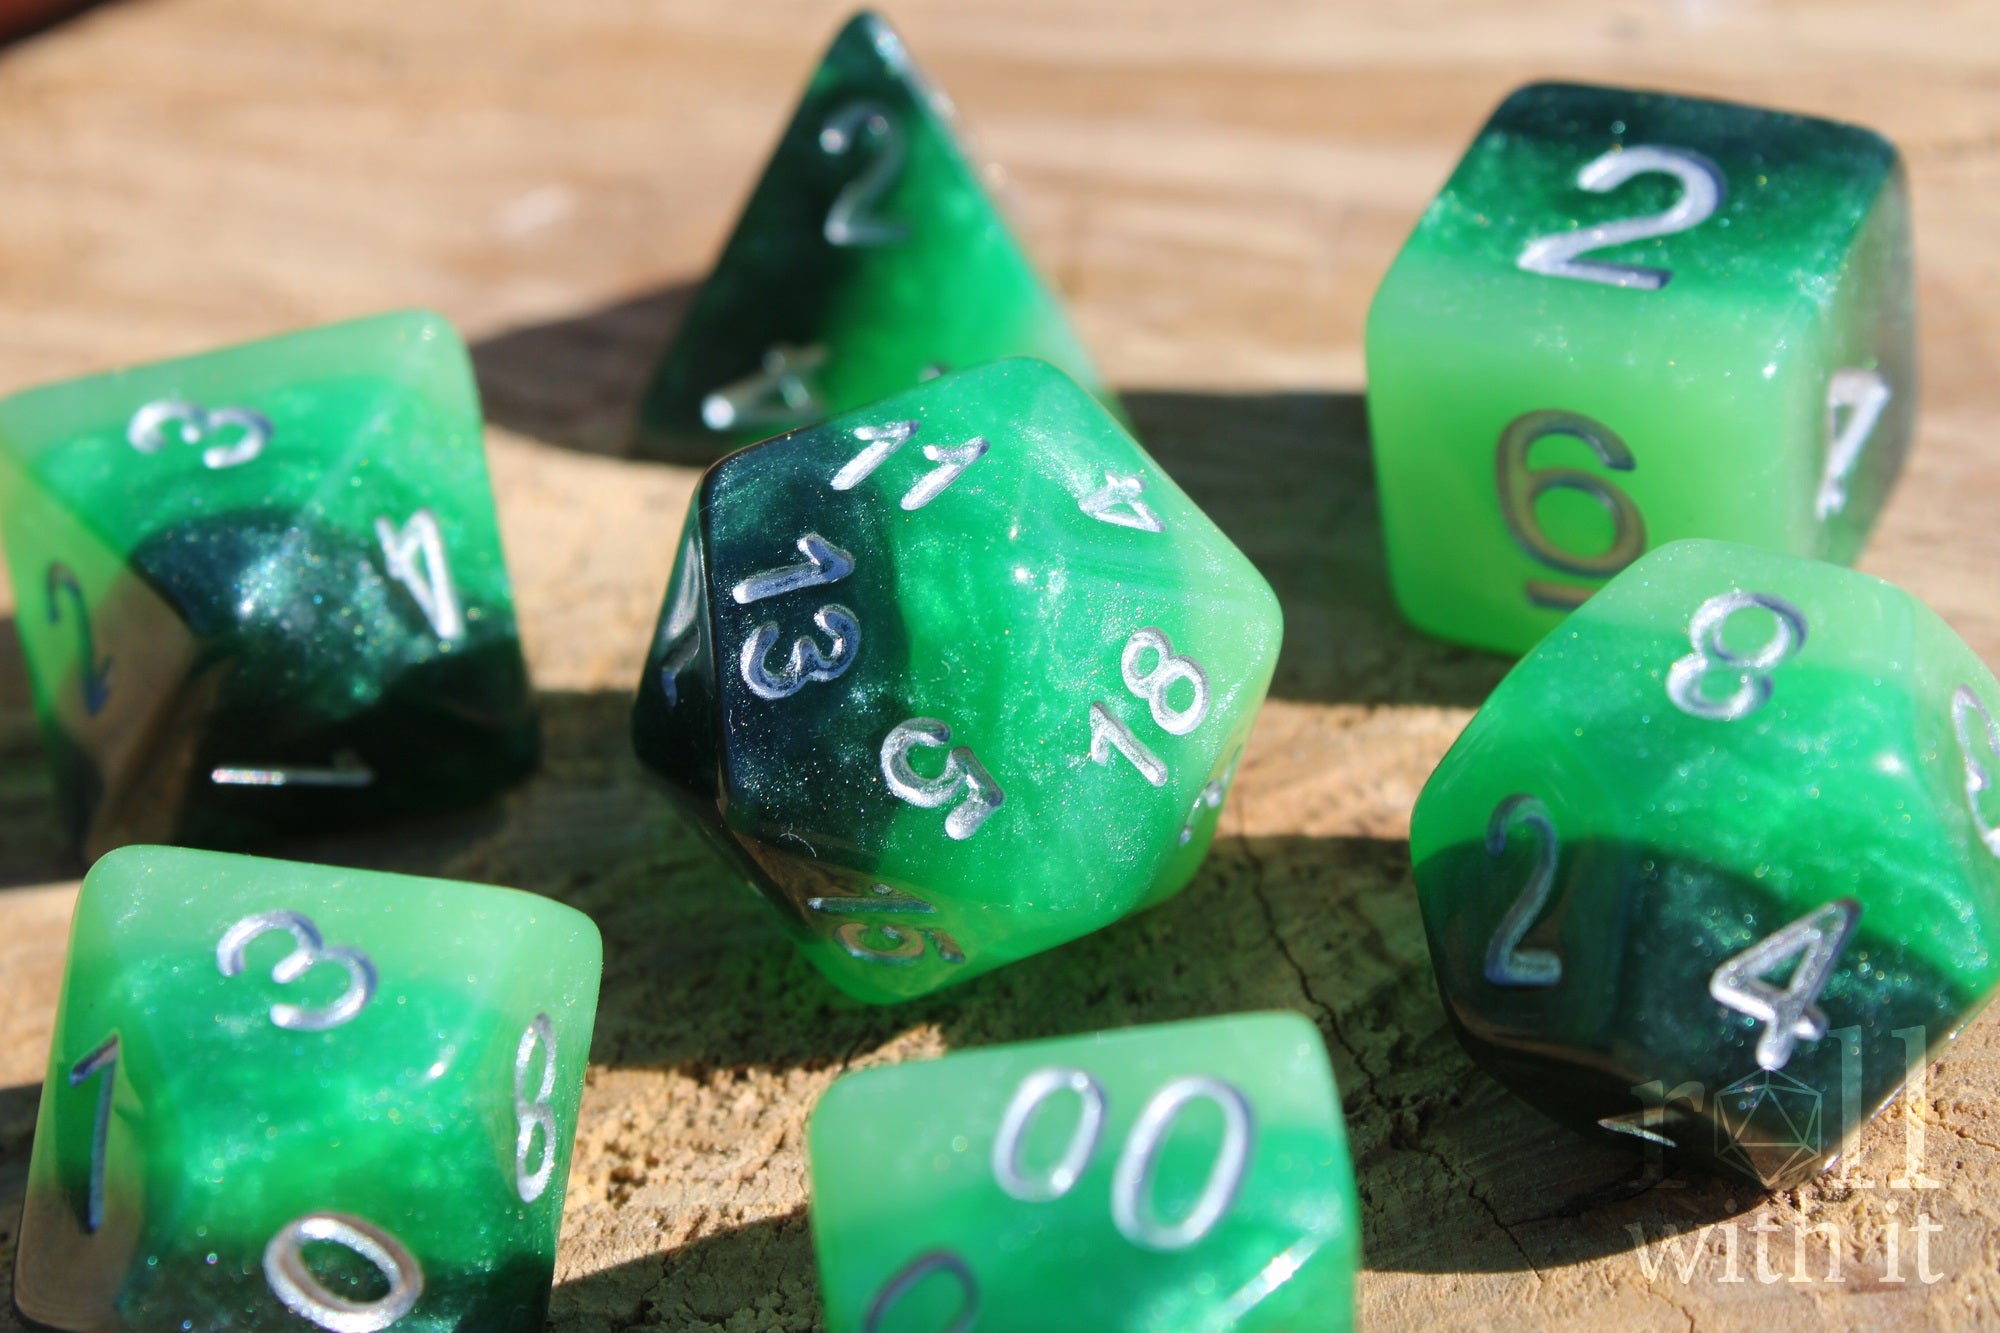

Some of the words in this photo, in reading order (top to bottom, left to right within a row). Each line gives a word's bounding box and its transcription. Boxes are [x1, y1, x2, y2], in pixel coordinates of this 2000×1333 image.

[819, 100, 912, 246] 2
[1516, 144, 1728, 290] 2
[127, 399, 273, 469] 3
[830, 419, 989, 509] 11
[1078, 470, 1165, 532] 4
[1495, 409, 1647, 580] 6
[375, 508, 463, 640] 4
[733, 533, 860, 700] 13
[1090, 625, 1210, 787] 18
[1666, 592, 1808, 720] 8
[880, 717, 1004, 840] 5
[1484, 793, 1562, 986] 2
[216, 910, 378, 1030] 3
[1711, 898, 1862, 1069] 4
[69, 1029, 119, 1233] 1
[514, 1013, 555, 1203] 8
[993, 1066, 1255, 1252] 00
[264, 1211, 424, 1333] 0
